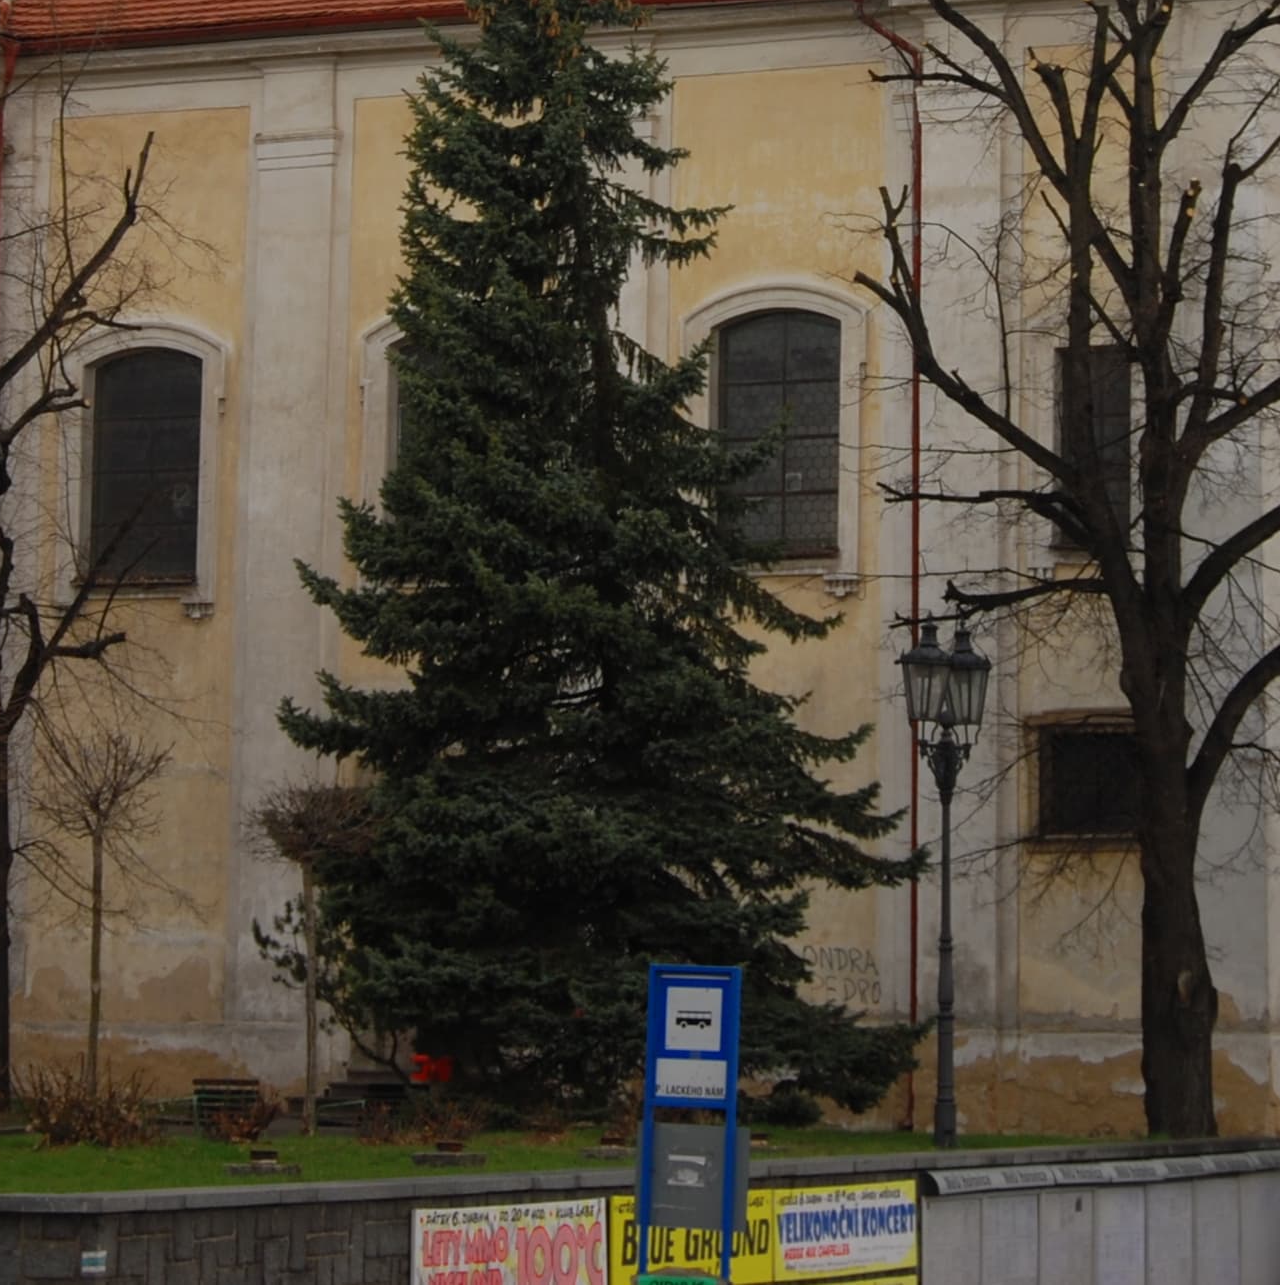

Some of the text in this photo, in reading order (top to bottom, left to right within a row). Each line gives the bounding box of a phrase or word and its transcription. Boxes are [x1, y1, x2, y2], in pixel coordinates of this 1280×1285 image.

[803, 945, 879, 975] ONDRA
[811, 976, 881, 1004] PEDRO
[656, 1083, 703, 1095] PLACKÉHO
[777, 1203, 915, 1244] VELIKONOČNÍ KONCERT
[423, 1230, 463, 1267] LETY
[622, 1218, 675, 1266] BUE
